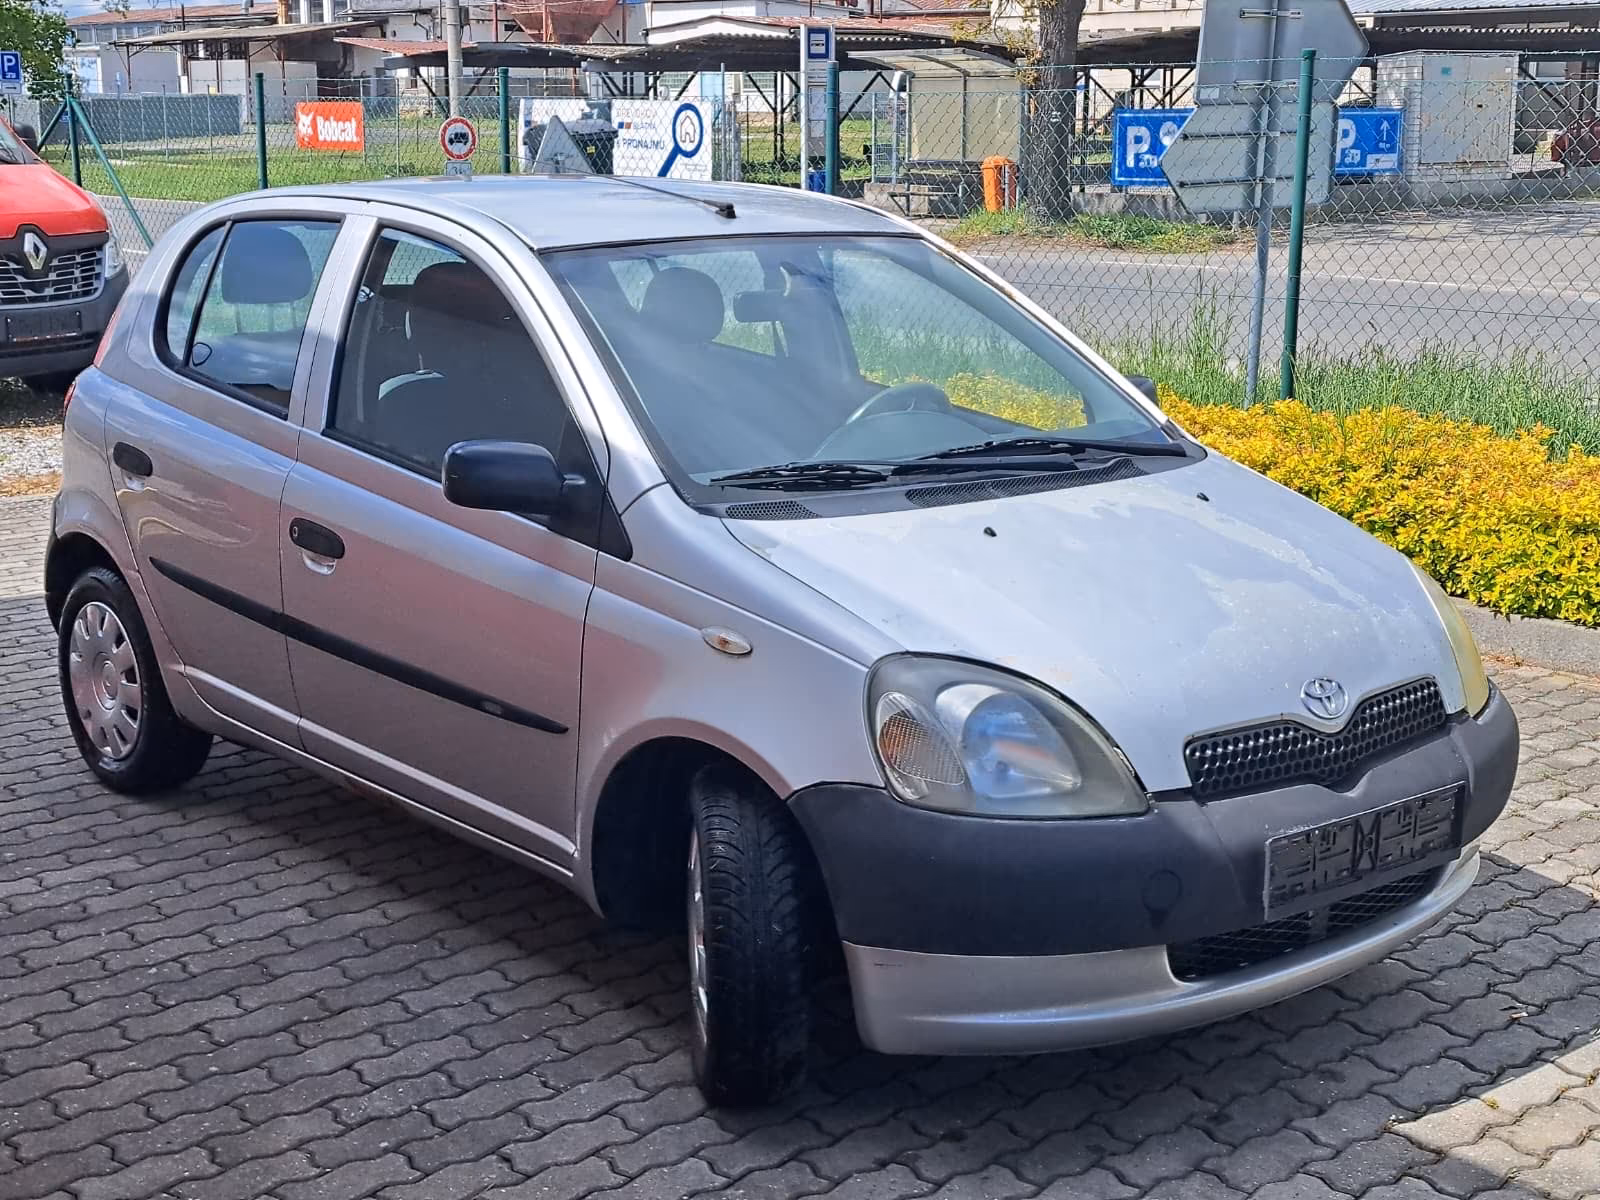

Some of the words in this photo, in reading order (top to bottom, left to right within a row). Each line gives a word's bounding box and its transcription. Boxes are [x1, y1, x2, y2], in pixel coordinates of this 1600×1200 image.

[3, 55, 16, 72] P
[316, 116, 357, 142] Bobcat
[1335, 118, 1356, 164] P
[1126, 126, 1151, 168] P
